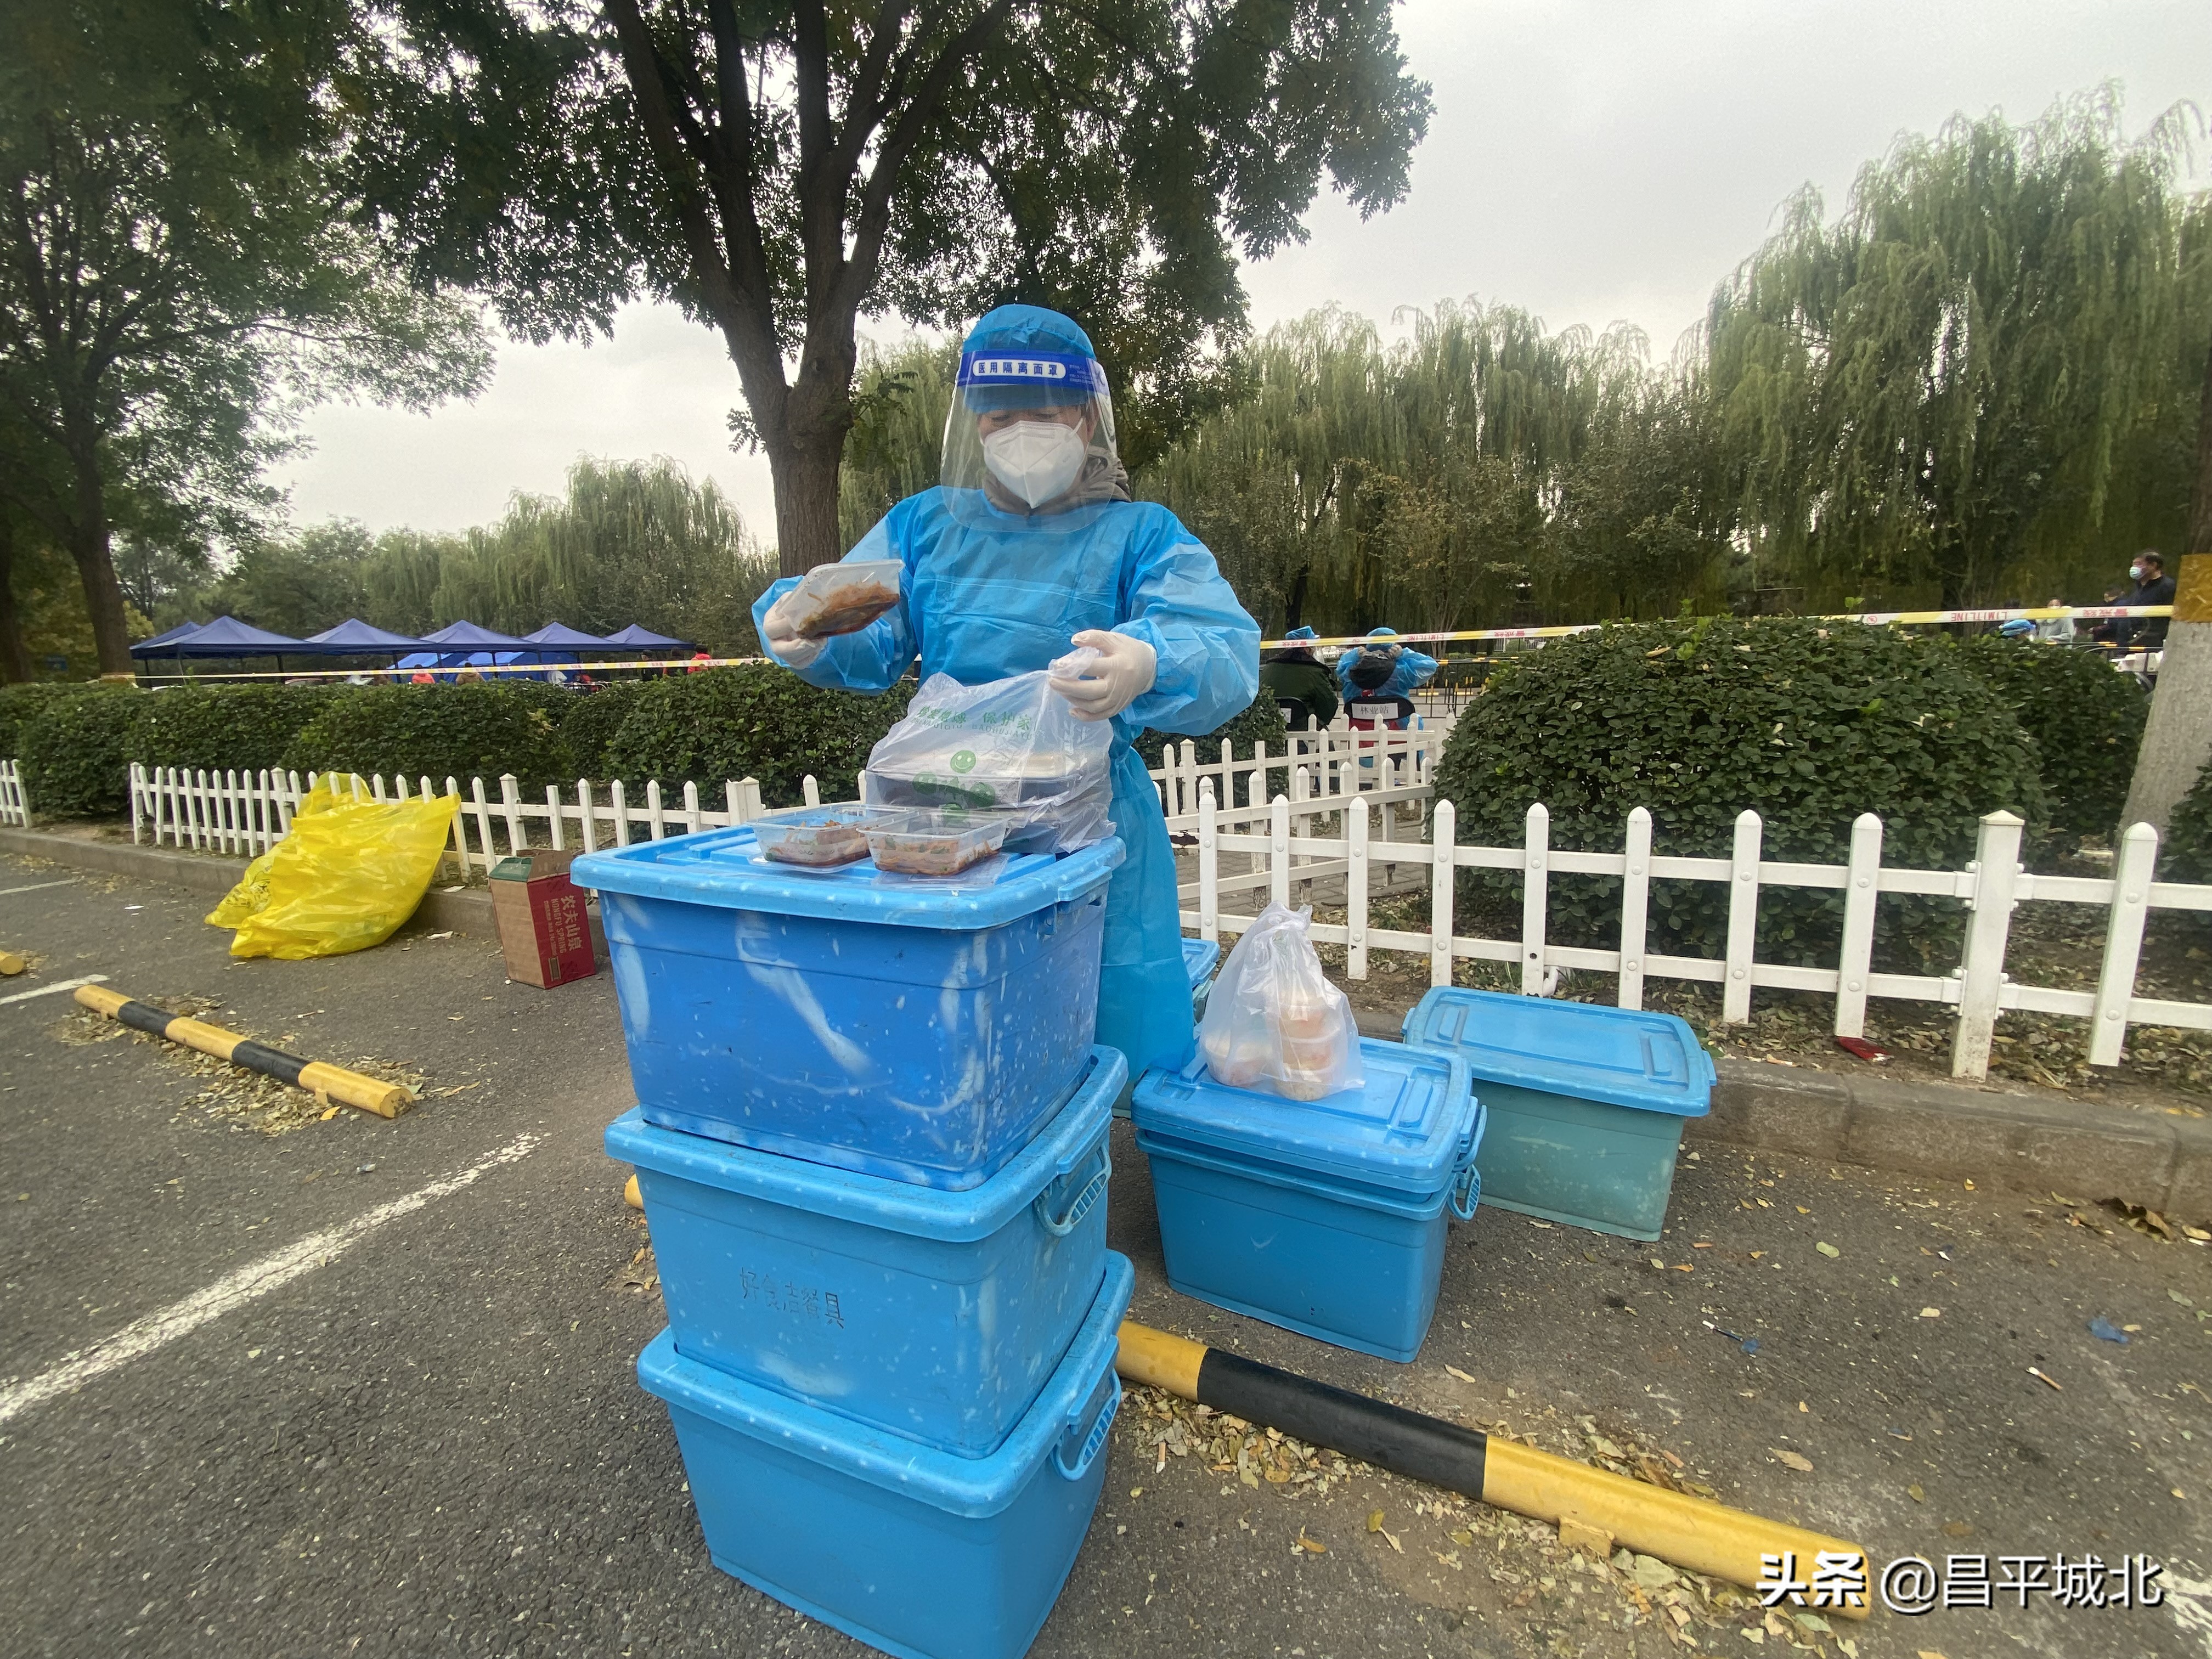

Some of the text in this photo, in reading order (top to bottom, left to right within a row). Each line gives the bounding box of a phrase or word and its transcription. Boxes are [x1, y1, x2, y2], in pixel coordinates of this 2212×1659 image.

[978, 362, 1058, 376] 医用隔离面罩
[1361, 705, 1389, 714] 林业站
[551, 898, 567, 953] NONGFU SPRING
[560, 895, 583, 952] 农夫山泉
